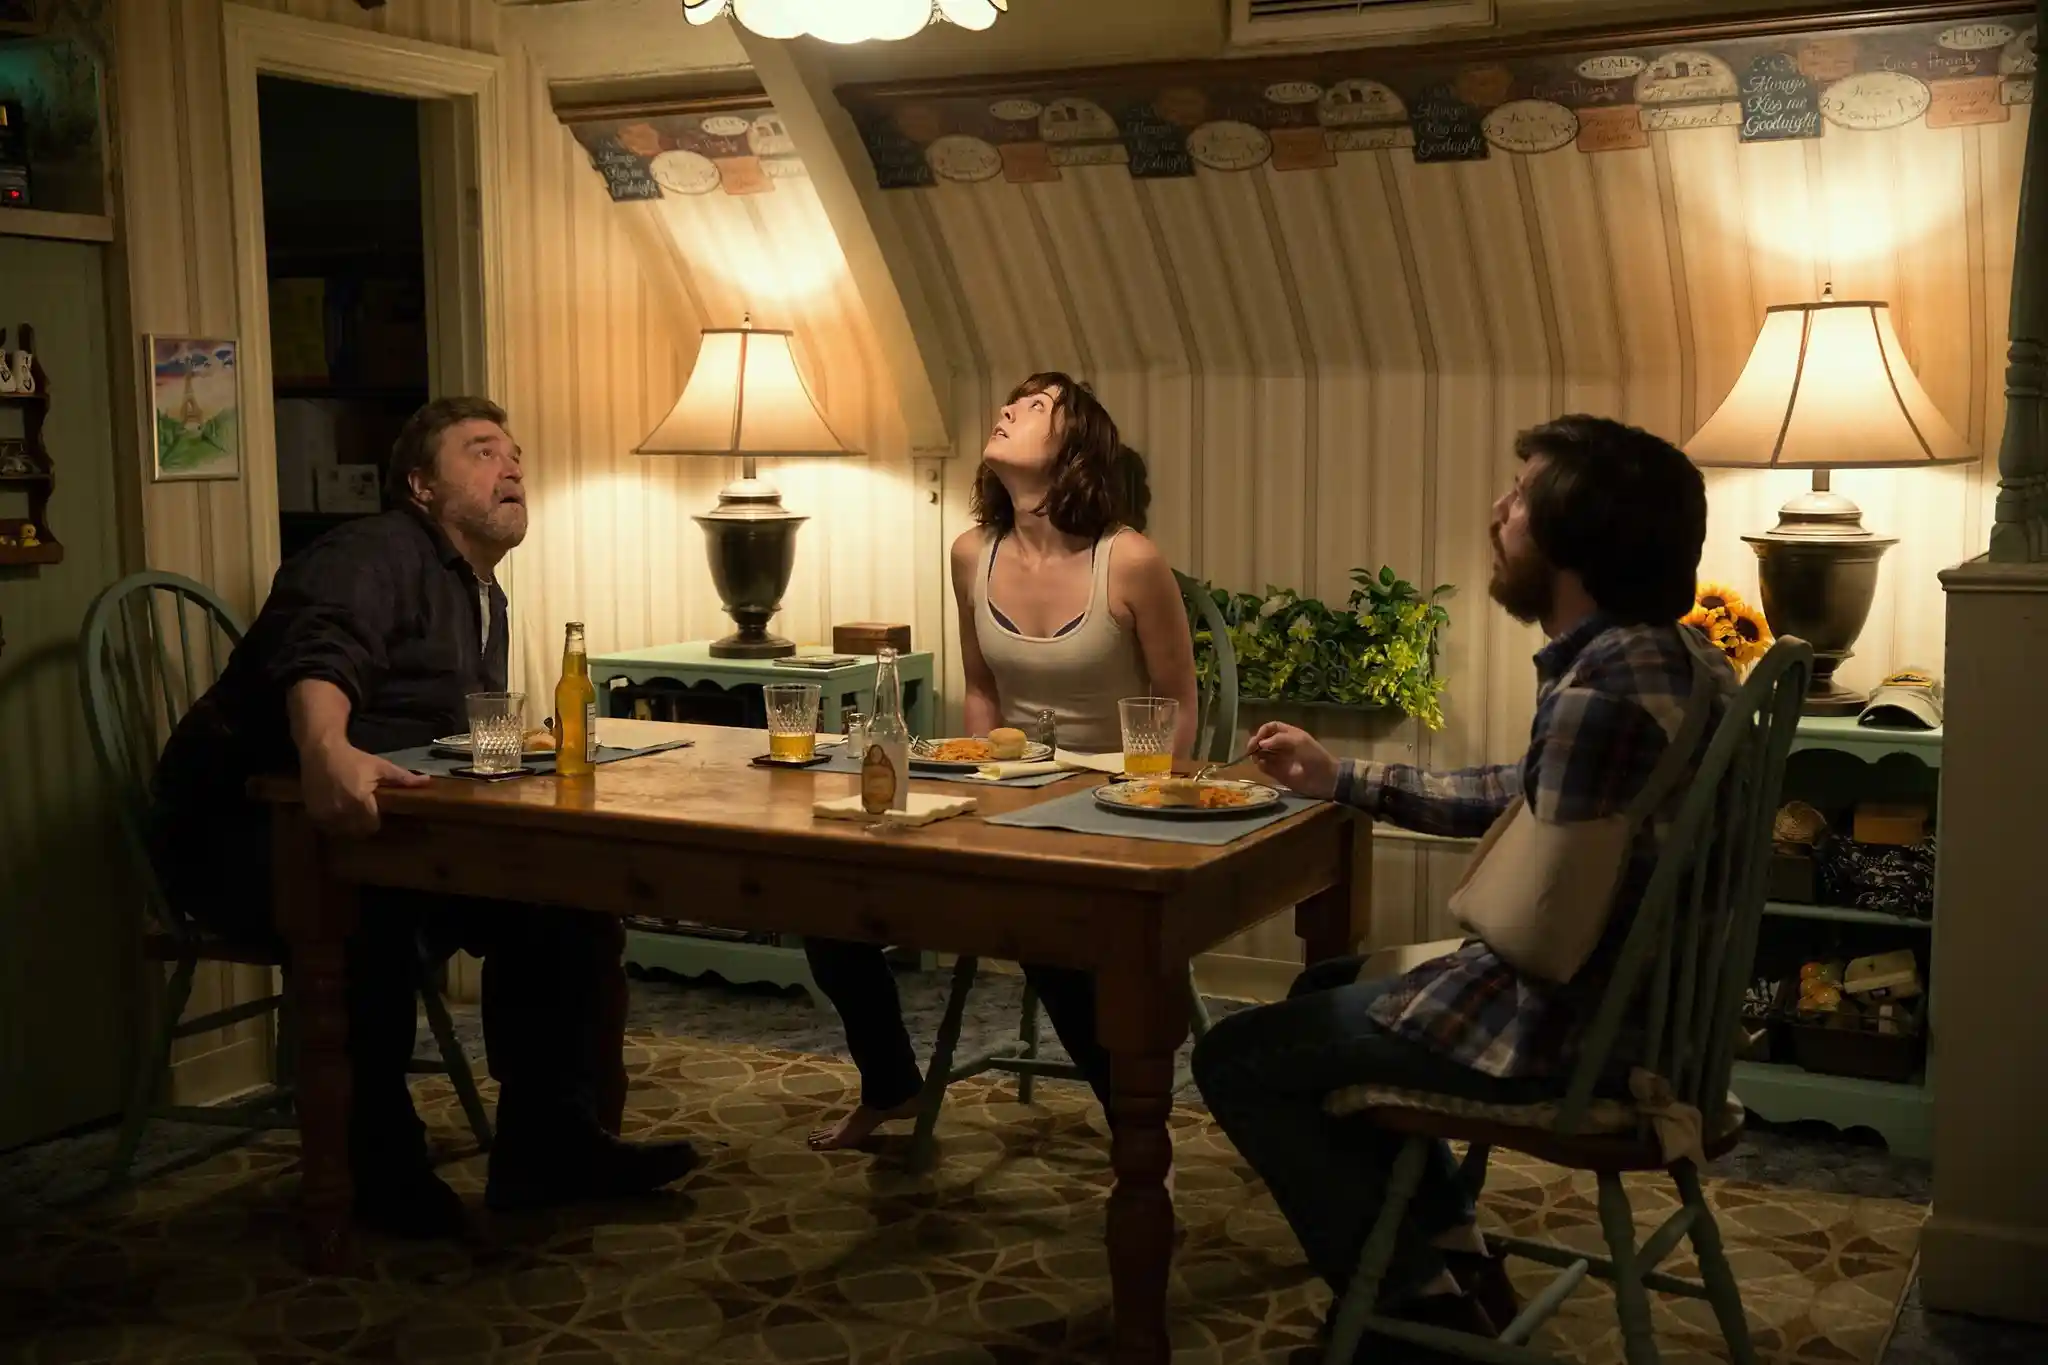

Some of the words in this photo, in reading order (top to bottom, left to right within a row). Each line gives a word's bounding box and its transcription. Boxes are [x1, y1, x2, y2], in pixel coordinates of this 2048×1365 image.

[1742, 75, 1807, 95] Always
[1747, 92, 1783, 116] Kiss
[1743, 111, 1818, 137] Goodnight
